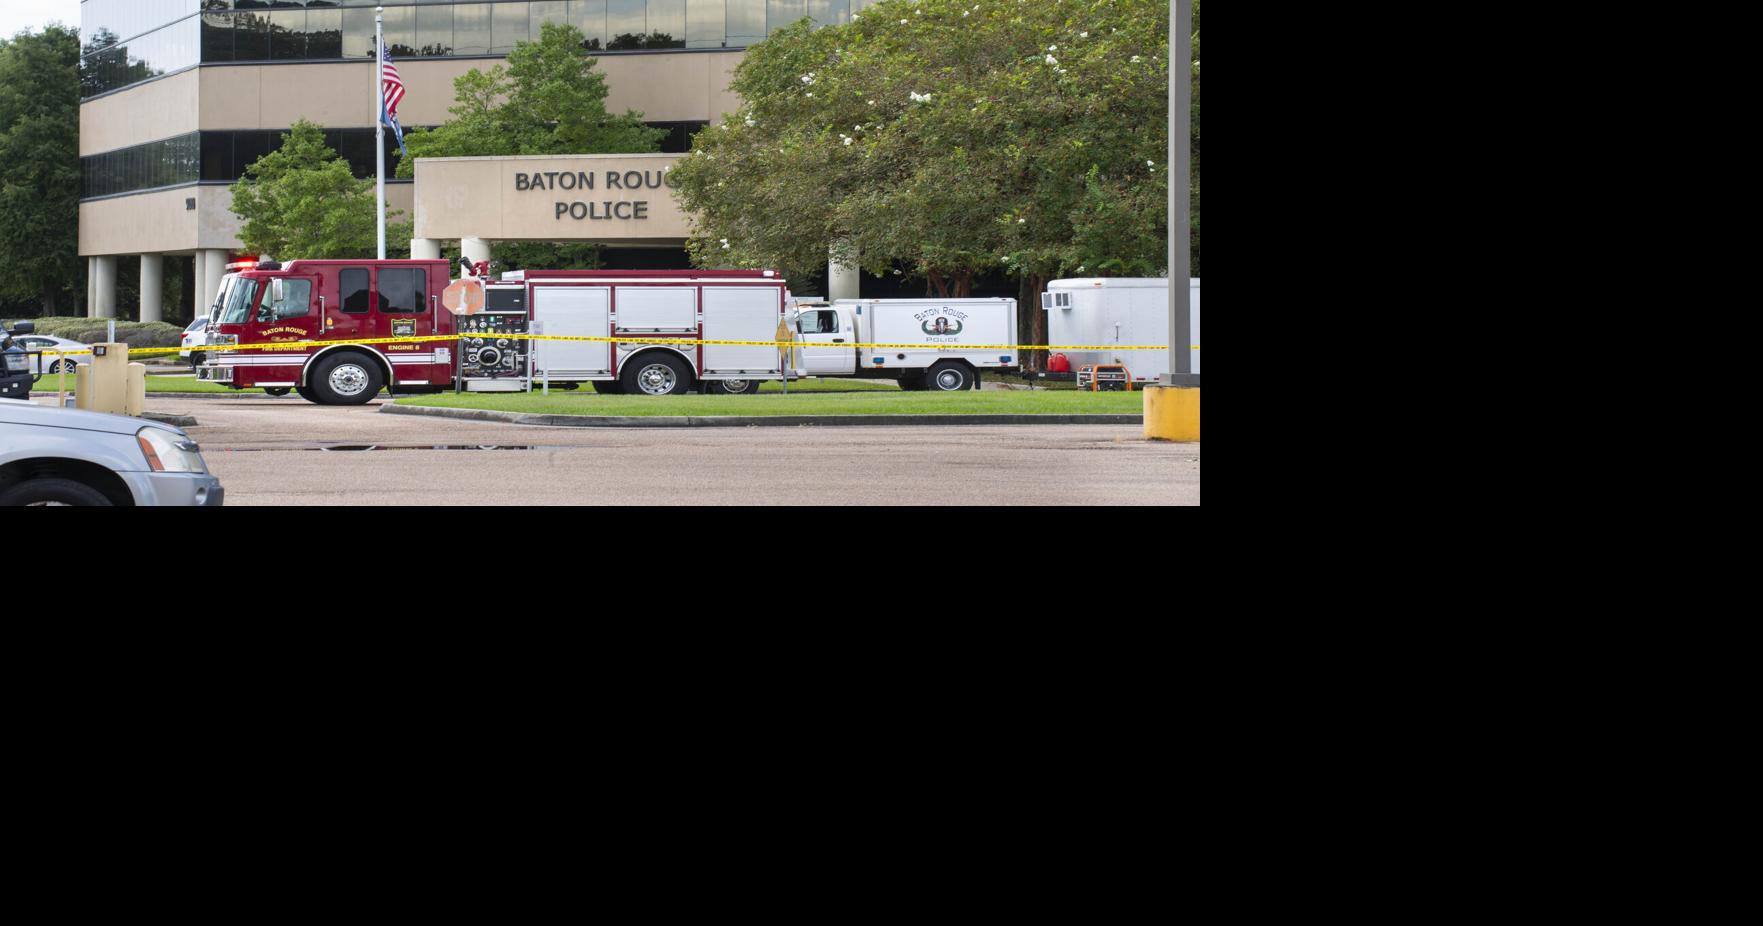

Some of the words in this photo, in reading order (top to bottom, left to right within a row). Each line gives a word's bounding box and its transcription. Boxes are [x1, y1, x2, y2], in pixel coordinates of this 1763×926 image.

[515, 171, 594, 191] BATON
[555, 200, 648, 220] POLICE
[914, 308, 940, 322] BATON
[942, 306, 969, 321] ROUGE
[262, 327, 284, 337] BATON
[285, 326, 308, 336] ROUGE
